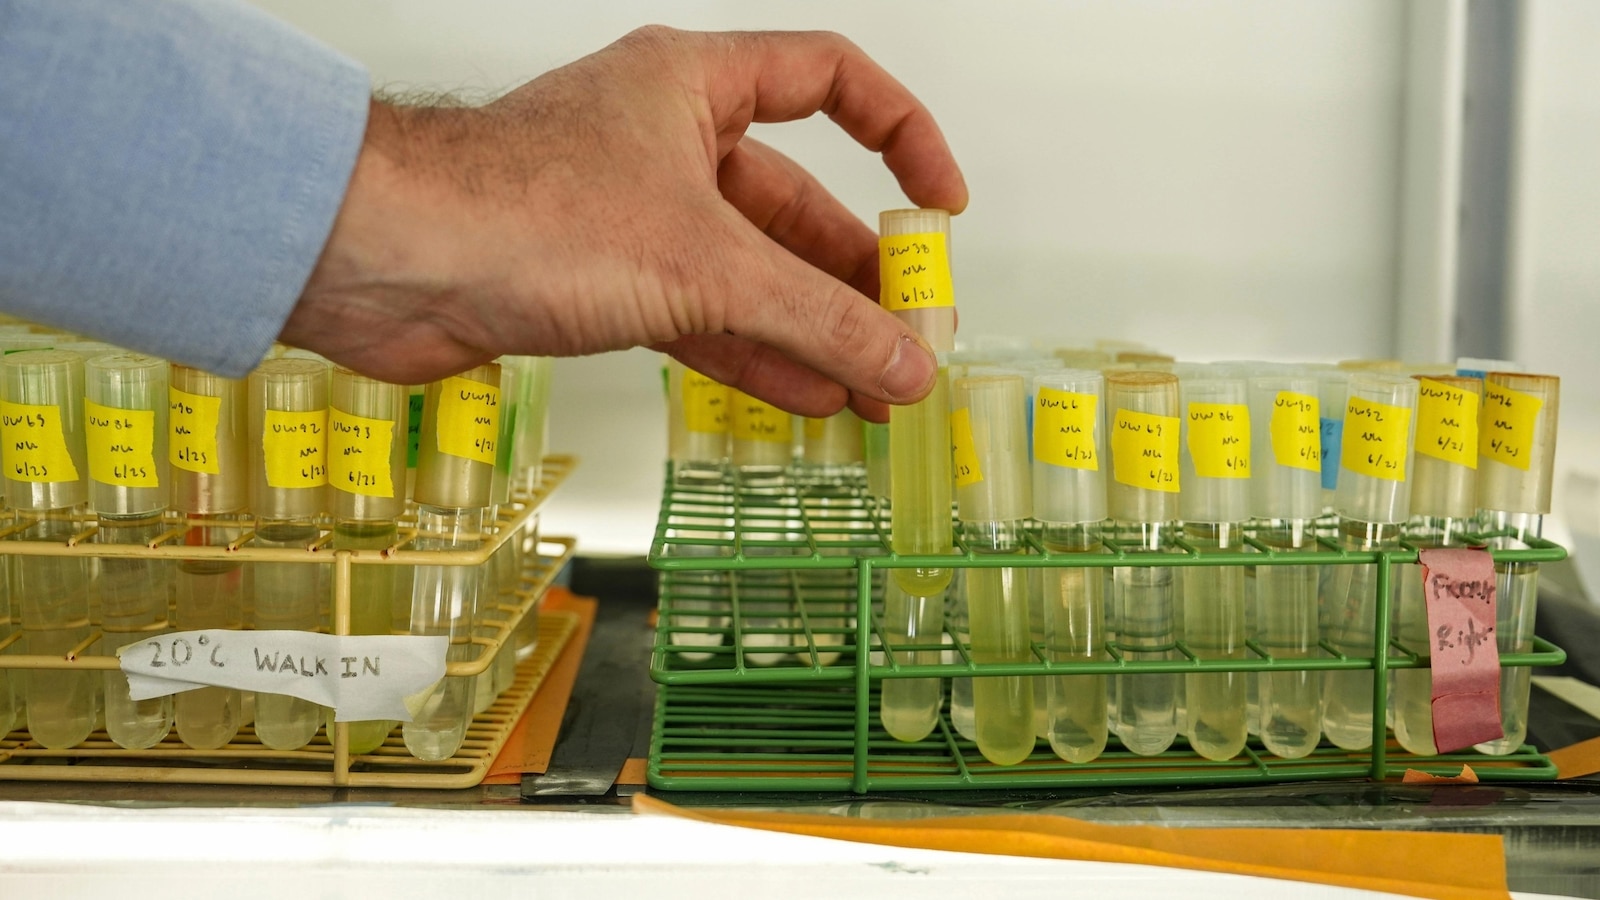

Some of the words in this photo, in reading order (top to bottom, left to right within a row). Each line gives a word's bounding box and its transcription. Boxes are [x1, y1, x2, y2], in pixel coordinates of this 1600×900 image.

[148, 634, 226, 668] 20°C
[253, 647, 329, 678] WALK
[340, 656, 382, 679] IN
